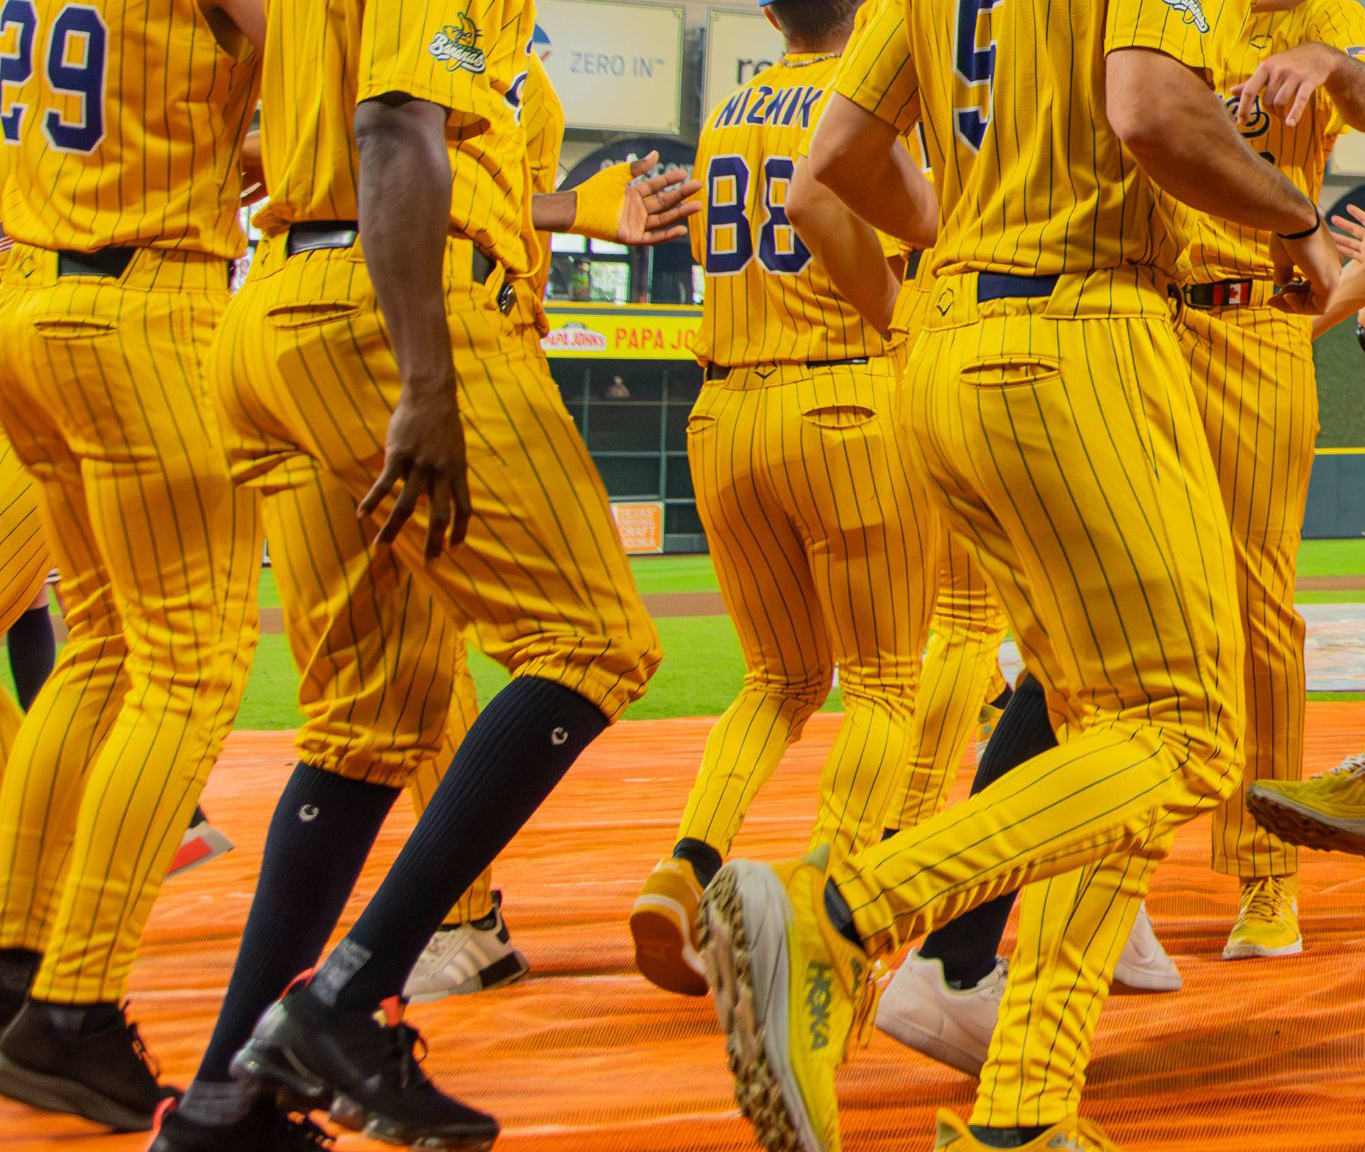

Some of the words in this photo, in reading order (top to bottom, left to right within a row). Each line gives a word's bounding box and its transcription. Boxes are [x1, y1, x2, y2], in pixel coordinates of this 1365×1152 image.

[571, 51, 624, 77] ZERO
[705, 155, 813, 276] 88
[615, 328, 664, 350] PAPA
[806, 958, 833, 1052] HOKA
